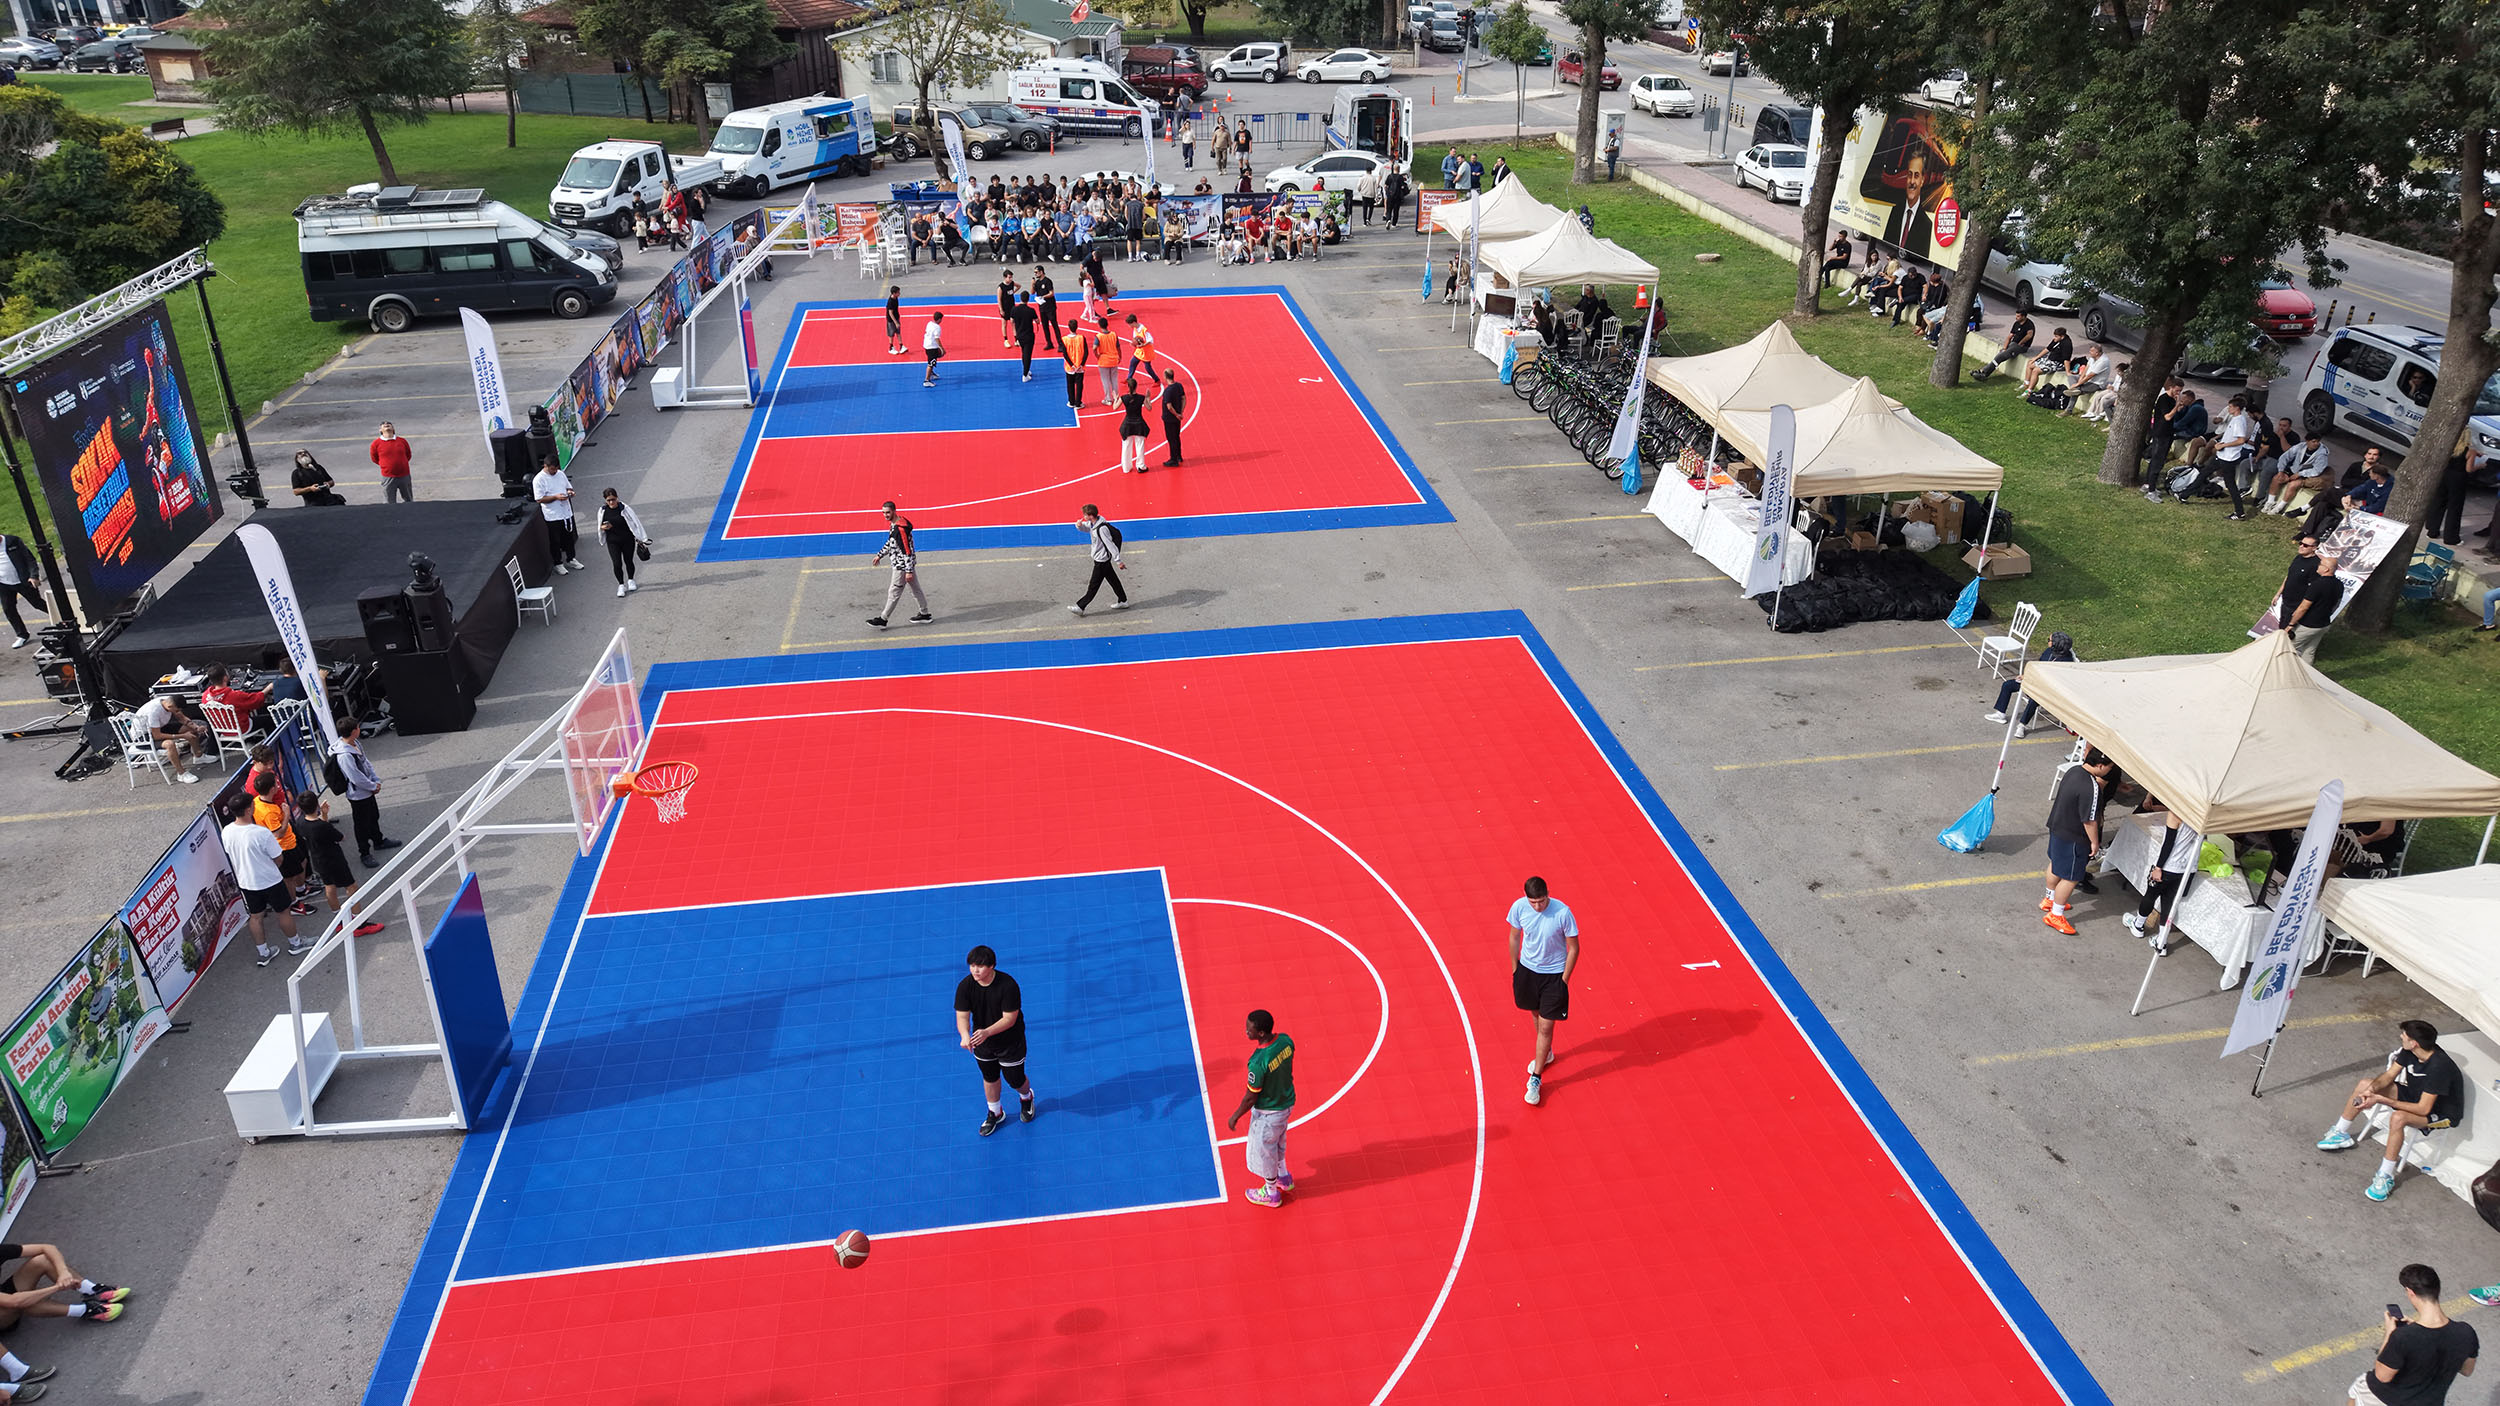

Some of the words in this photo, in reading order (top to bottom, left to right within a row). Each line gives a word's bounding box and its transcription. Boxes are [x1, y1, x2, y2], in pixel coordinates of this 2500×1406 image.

[545, 33, 571, 45] WC
[1030, 89, 1046, 97] 112
[1298, 376, 1324, 384] 2
[2405, 411, 2424, 423] ZABIT
[70, 416, 122, 512] SOKAK
[146, 871, 176, 908] Kültür
[136, 926, 148, 943] ve
[147, 890, 179, 935] Kongre
[139, 917, 178, 958] Merkezi
[1680, 959, 1721, 970] 1
[8, 1018, 48, 1068] Ferizli
[47, 971, 91, 1025] Atatürk
[17, 1041, 51, 1084] Parkı
